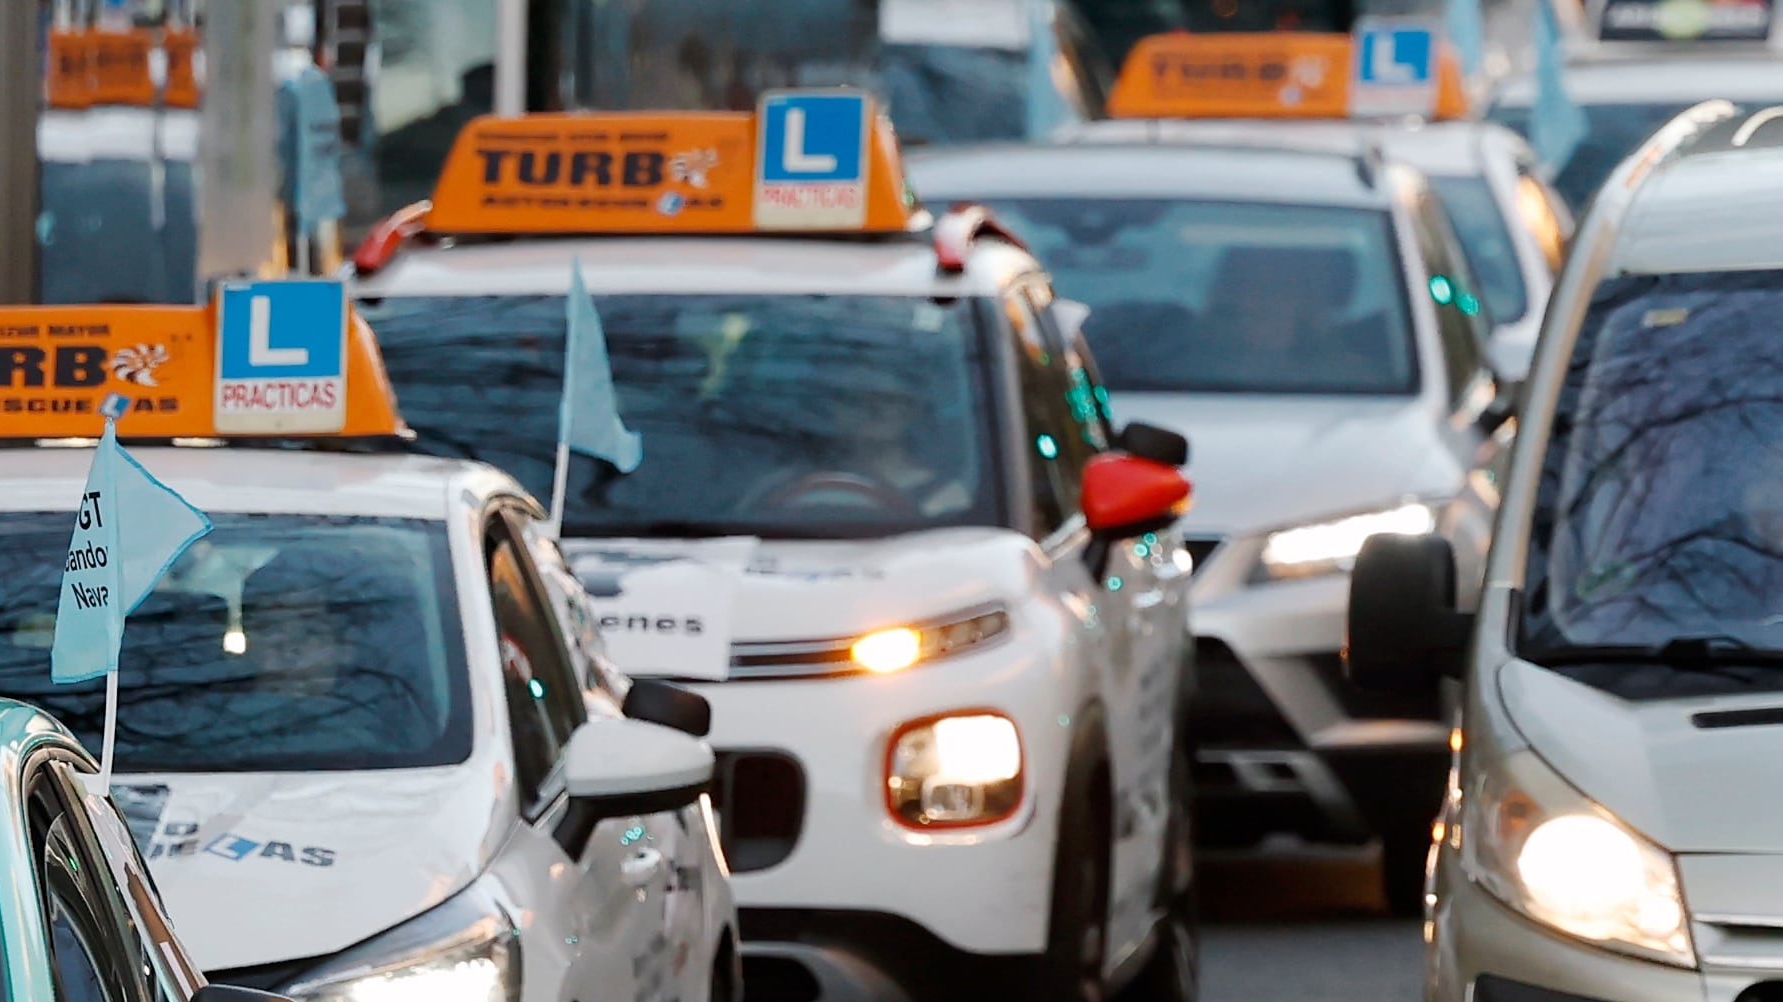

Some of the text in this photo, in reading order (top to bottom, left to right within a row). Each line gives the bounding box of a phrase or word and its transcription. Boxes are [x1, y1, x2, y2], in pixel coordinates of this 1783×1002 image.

[783, 107, 838, 173] L
[249, 295, 309, 367] L
[222, 382, 336, 409] PRACTICAS
